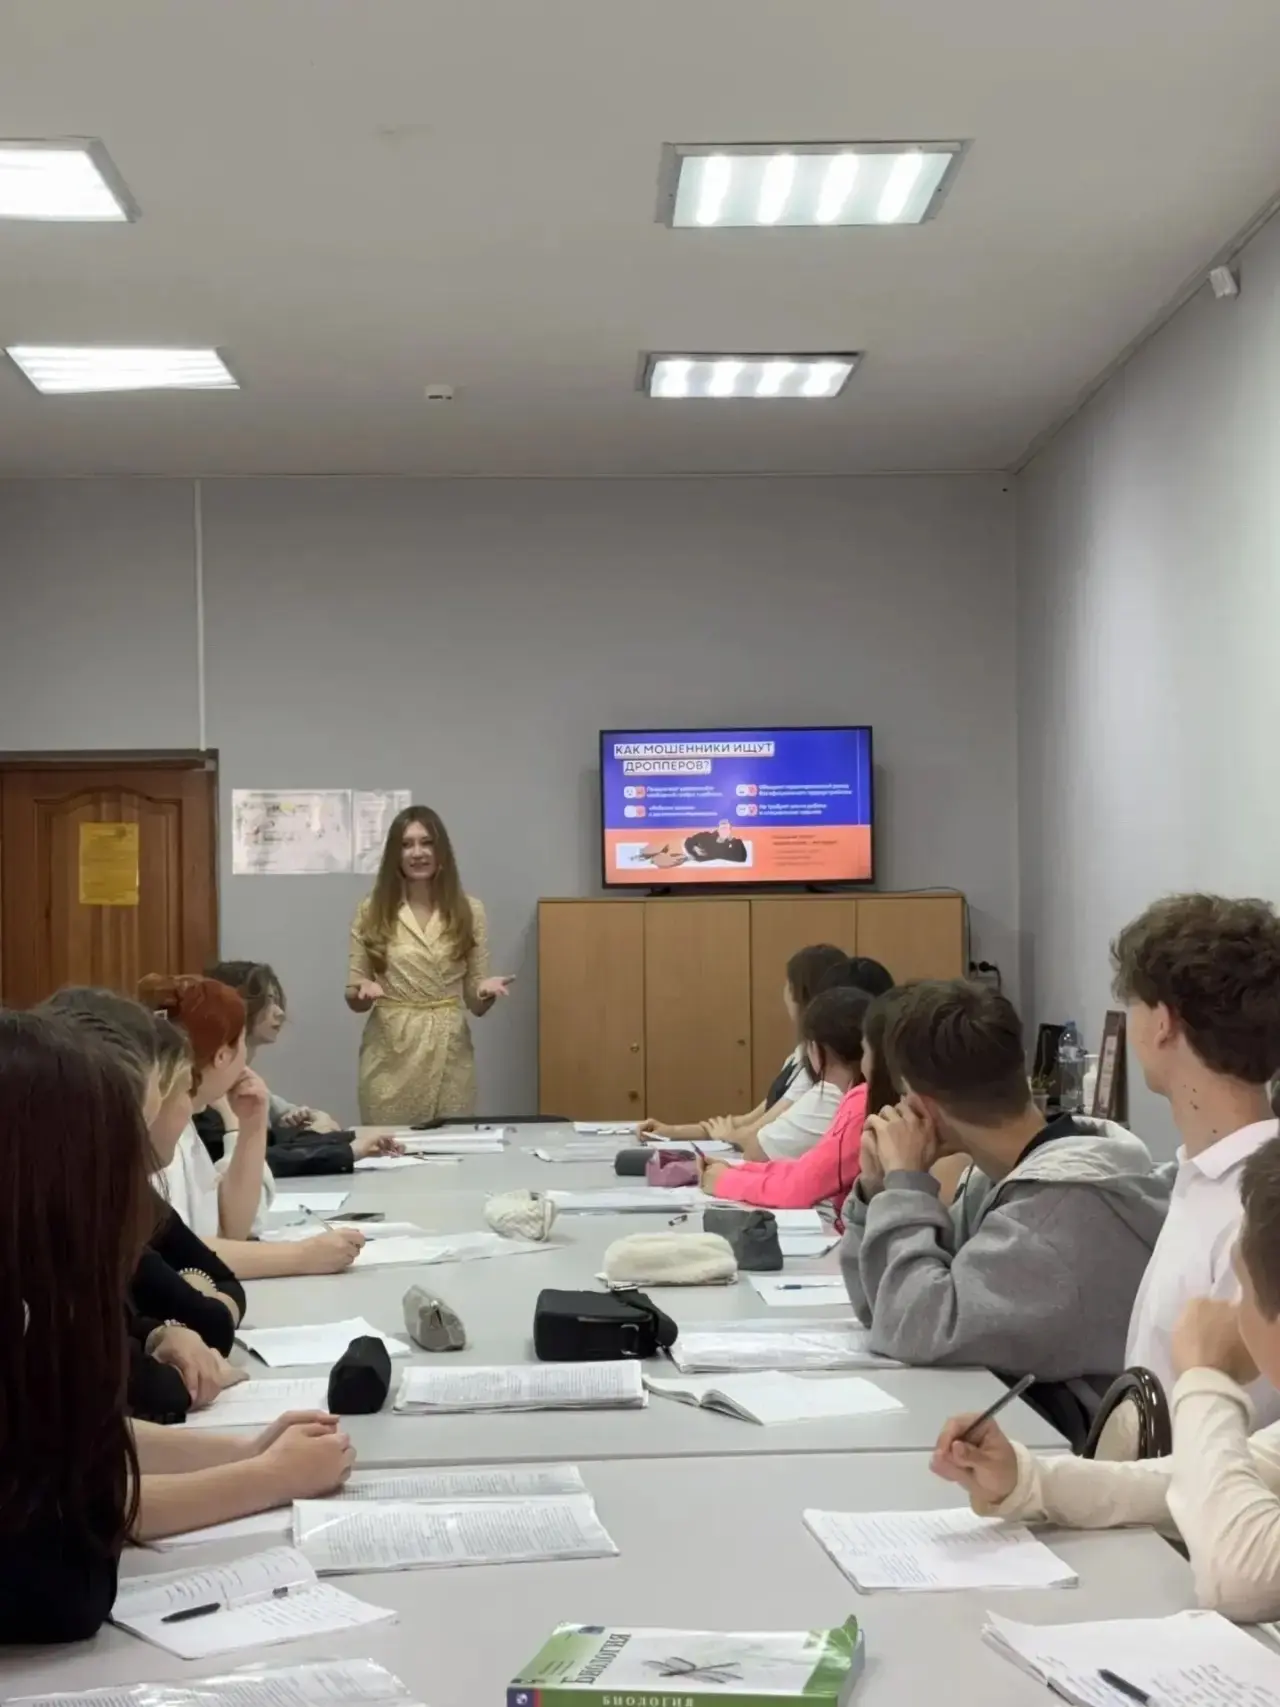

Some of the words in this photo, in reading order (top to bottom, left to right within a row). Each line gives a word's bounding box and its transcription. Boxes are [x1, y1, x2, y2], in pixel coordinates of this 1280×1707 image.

[615, 744, 640, 755] КАК
[644, 743, 730, 754] МОШЕННИКИ
[733, 742, 773, 753] ИЩУТ
[625, 760, 710, 772] ДРОППЕРОВ?
[602, 1695, 694, 1707] БИОЛОГИЯ
